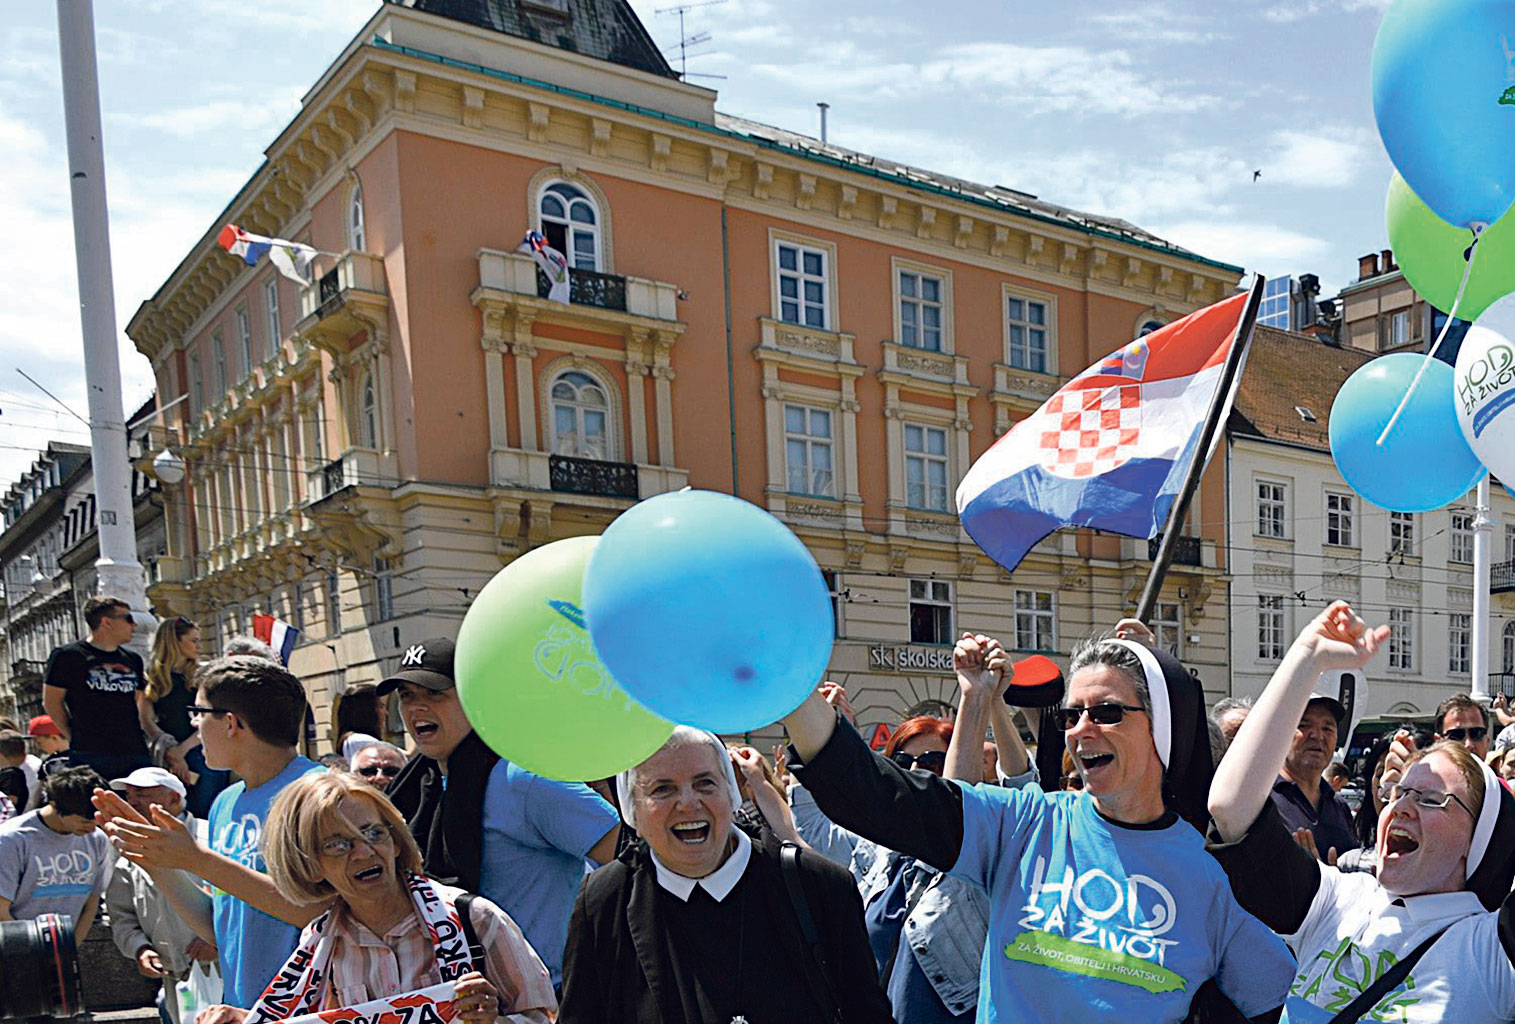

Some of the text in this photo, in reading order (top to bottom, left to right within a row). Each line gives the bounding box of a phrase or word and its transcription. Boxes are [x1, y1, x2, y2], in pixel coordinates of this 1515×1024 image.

[1458, 344, 1514, 404] HOD
[34, 849, 92, 878] HOD
[1028, 854, 1177, 937] HOD
[1018, 903, 1181, 968] ZA ŽIVOT
[1018, 941, 1031, 953] ZA
[1032, 944, 1065, 963] ŽIVOT,
[1065, 953, 1105, 971] OBITELJ
[1111, 965, 1167, 985] HRVATSKU
